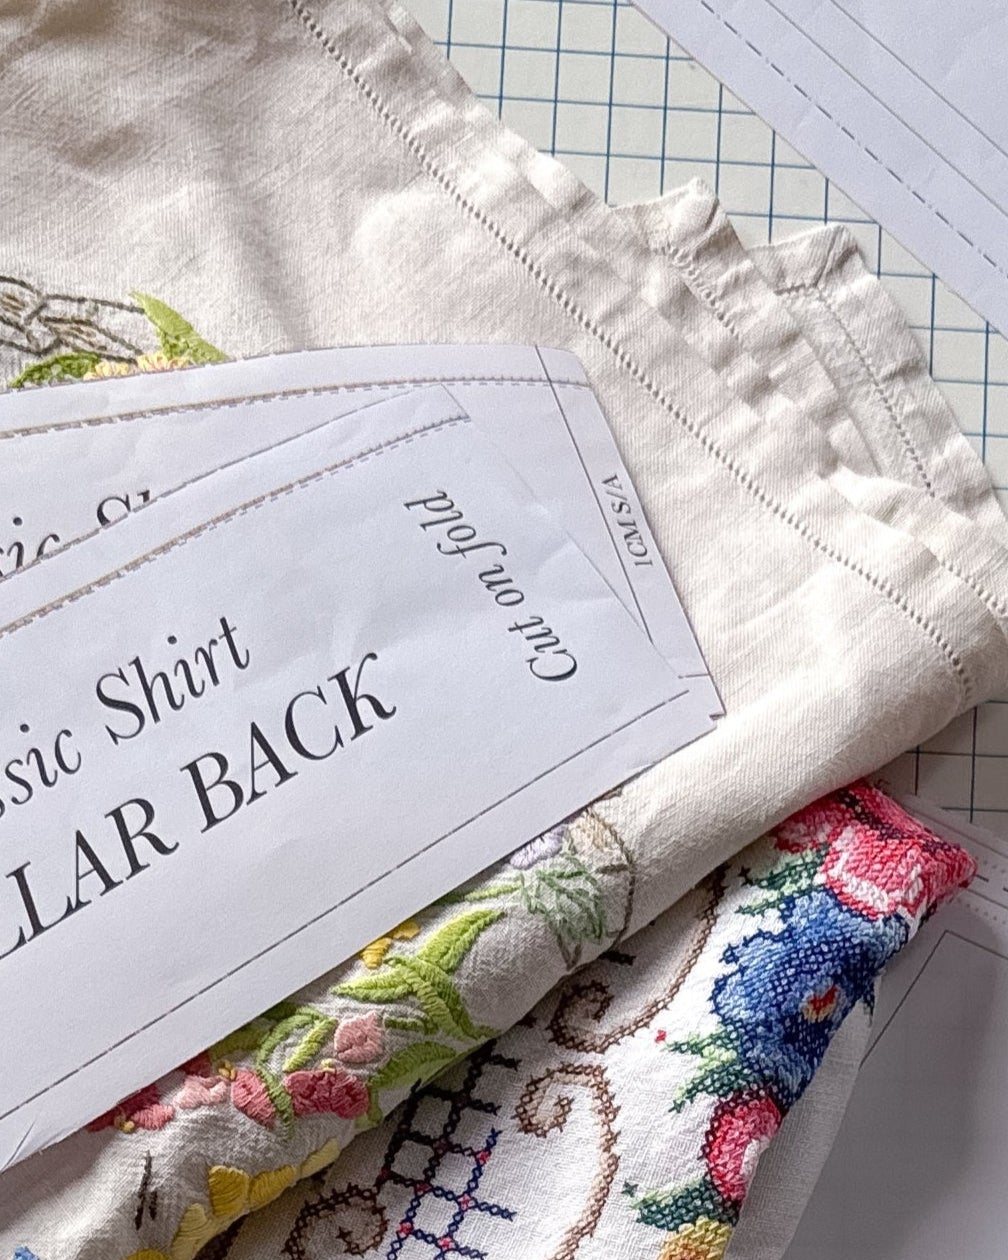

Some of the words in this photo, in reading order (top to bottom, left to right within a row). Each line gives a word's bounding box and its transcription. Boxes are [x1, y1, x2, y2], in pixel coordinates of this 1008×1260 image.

[403, 489, 508, 559] fold
[601, 474, 631, 514] S/A
[478, 563, 525, 607] on
[507, 615, 578, 682] Cut
[0, 723, 82, 820] sic
[95, 616, 251, 745] Shirt
[180, 652, 398, 833] BACK
